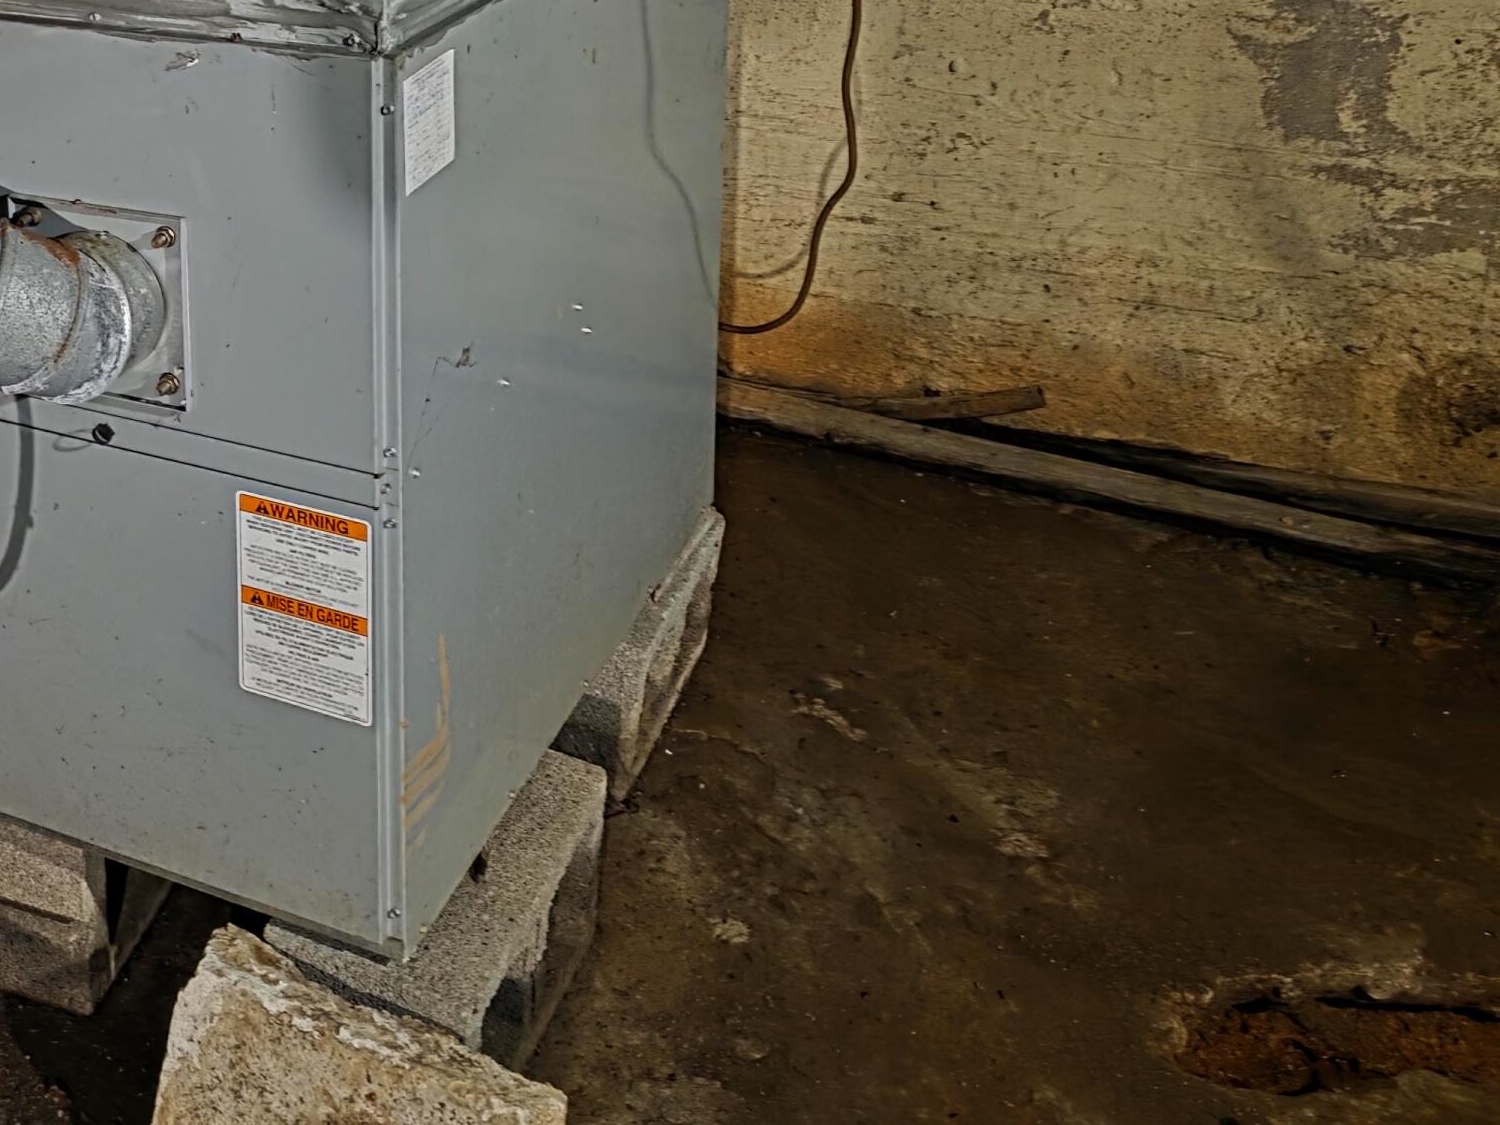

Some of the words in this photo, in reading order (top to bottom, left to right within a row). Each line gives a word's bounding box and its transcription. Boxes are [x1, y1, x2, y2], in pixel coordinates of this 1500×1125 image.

[270, 503, 349, 535] WARNING
[266, 594, 295, 614] MISE
[297, 604, 313, 618] EN
[316, 608, 360, 632] GARDE
